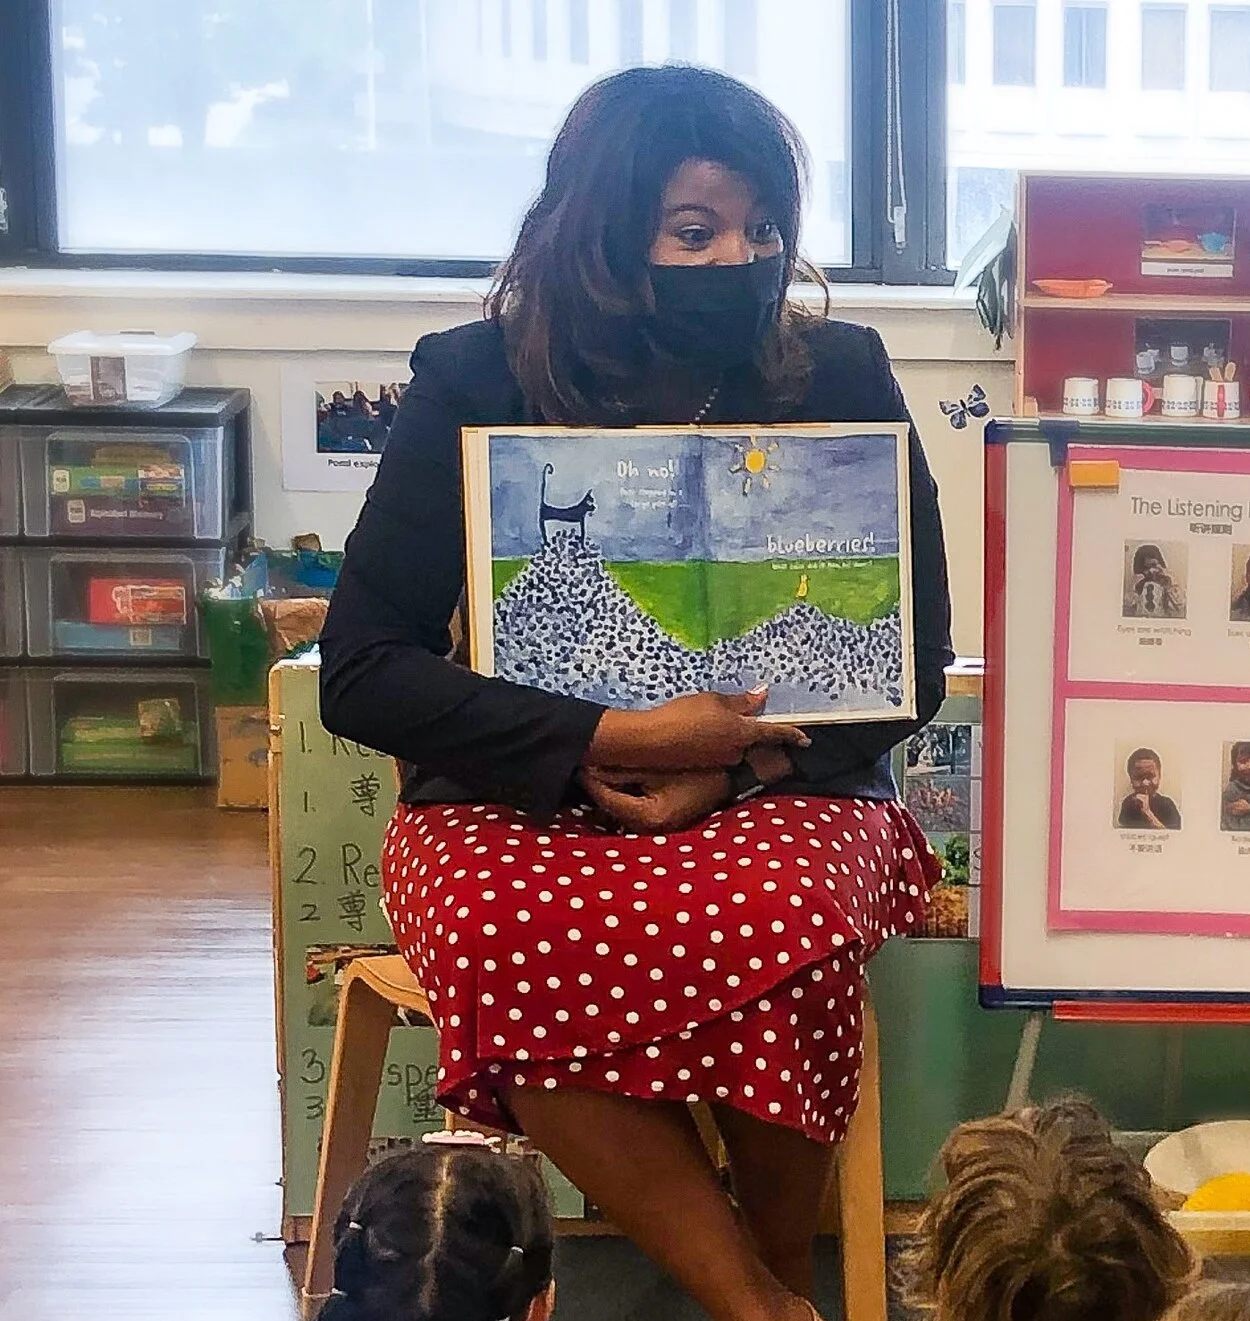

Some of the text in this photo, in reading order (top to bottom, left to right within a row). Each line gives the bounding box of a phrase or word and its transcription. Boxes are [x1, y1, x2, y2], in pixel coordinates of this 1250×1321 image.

[616, 458, 676, 480] Oh no!
[1131, 496, 1162, 516] The
[1167, 498, 1244, 523] Listening
[766, 531, 877, 554] blueberries!
